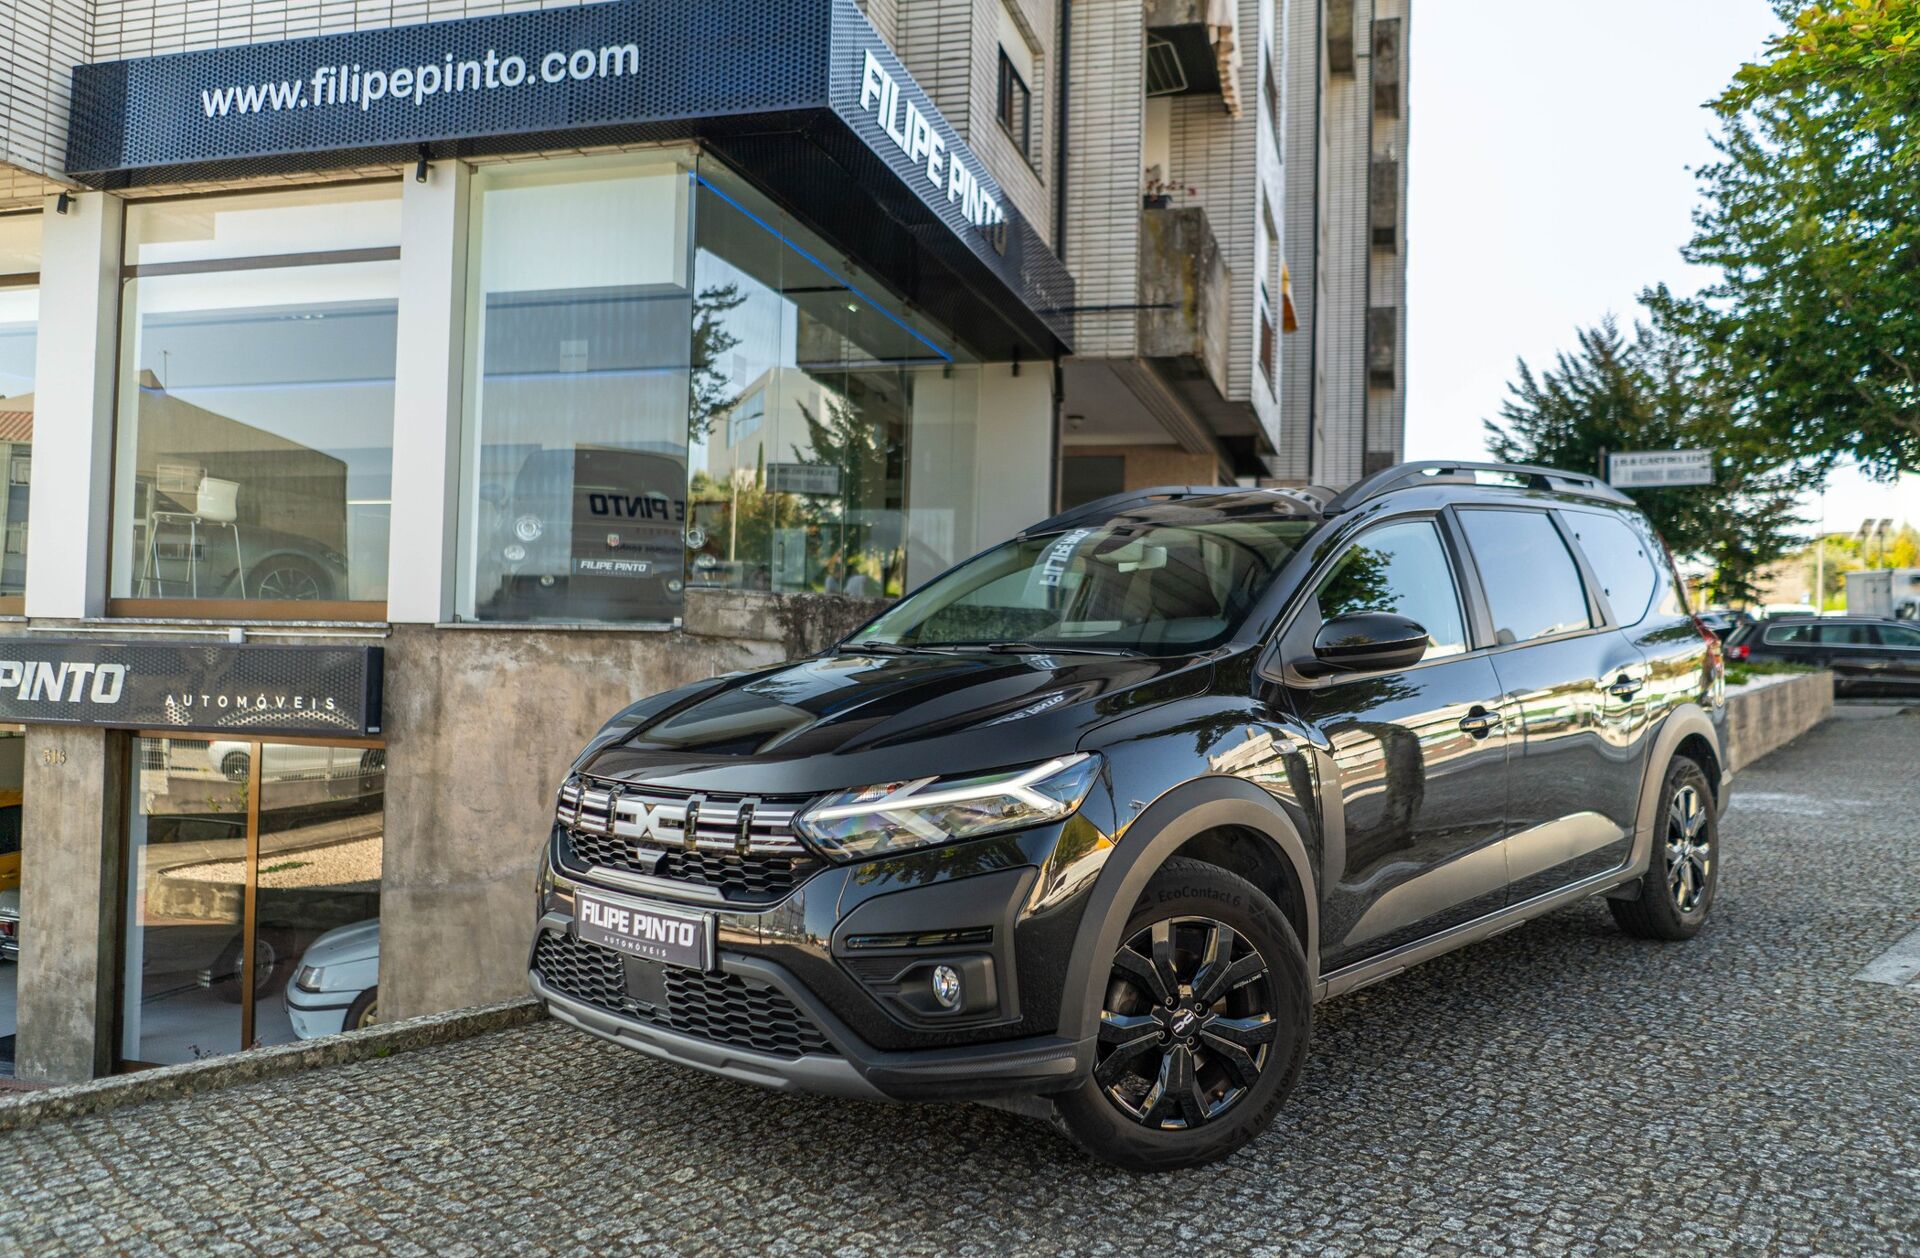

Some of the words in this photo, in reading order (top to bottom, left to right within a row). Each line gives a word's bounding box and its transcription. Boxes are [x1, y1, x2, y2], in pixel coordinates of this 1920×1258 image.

[202, 43, 640, 118] www.filipepinto.com
[859, 49, 945, 190] FILIPE
[947, 152, 1007, 257] PINTO
[580, 560, 613, 570] FILIPE
[615, 562, 647, 572] PINTO
[165, 693, 336, 710] AUTOMÓVEIS
[1158, 886, 1231, 904] EcoContact
[581, 900, 629, 934] FILIPE
[633, 913, 695, 947] PINTO
[603, 935, 667, 957] AUTOMÓVEIS
